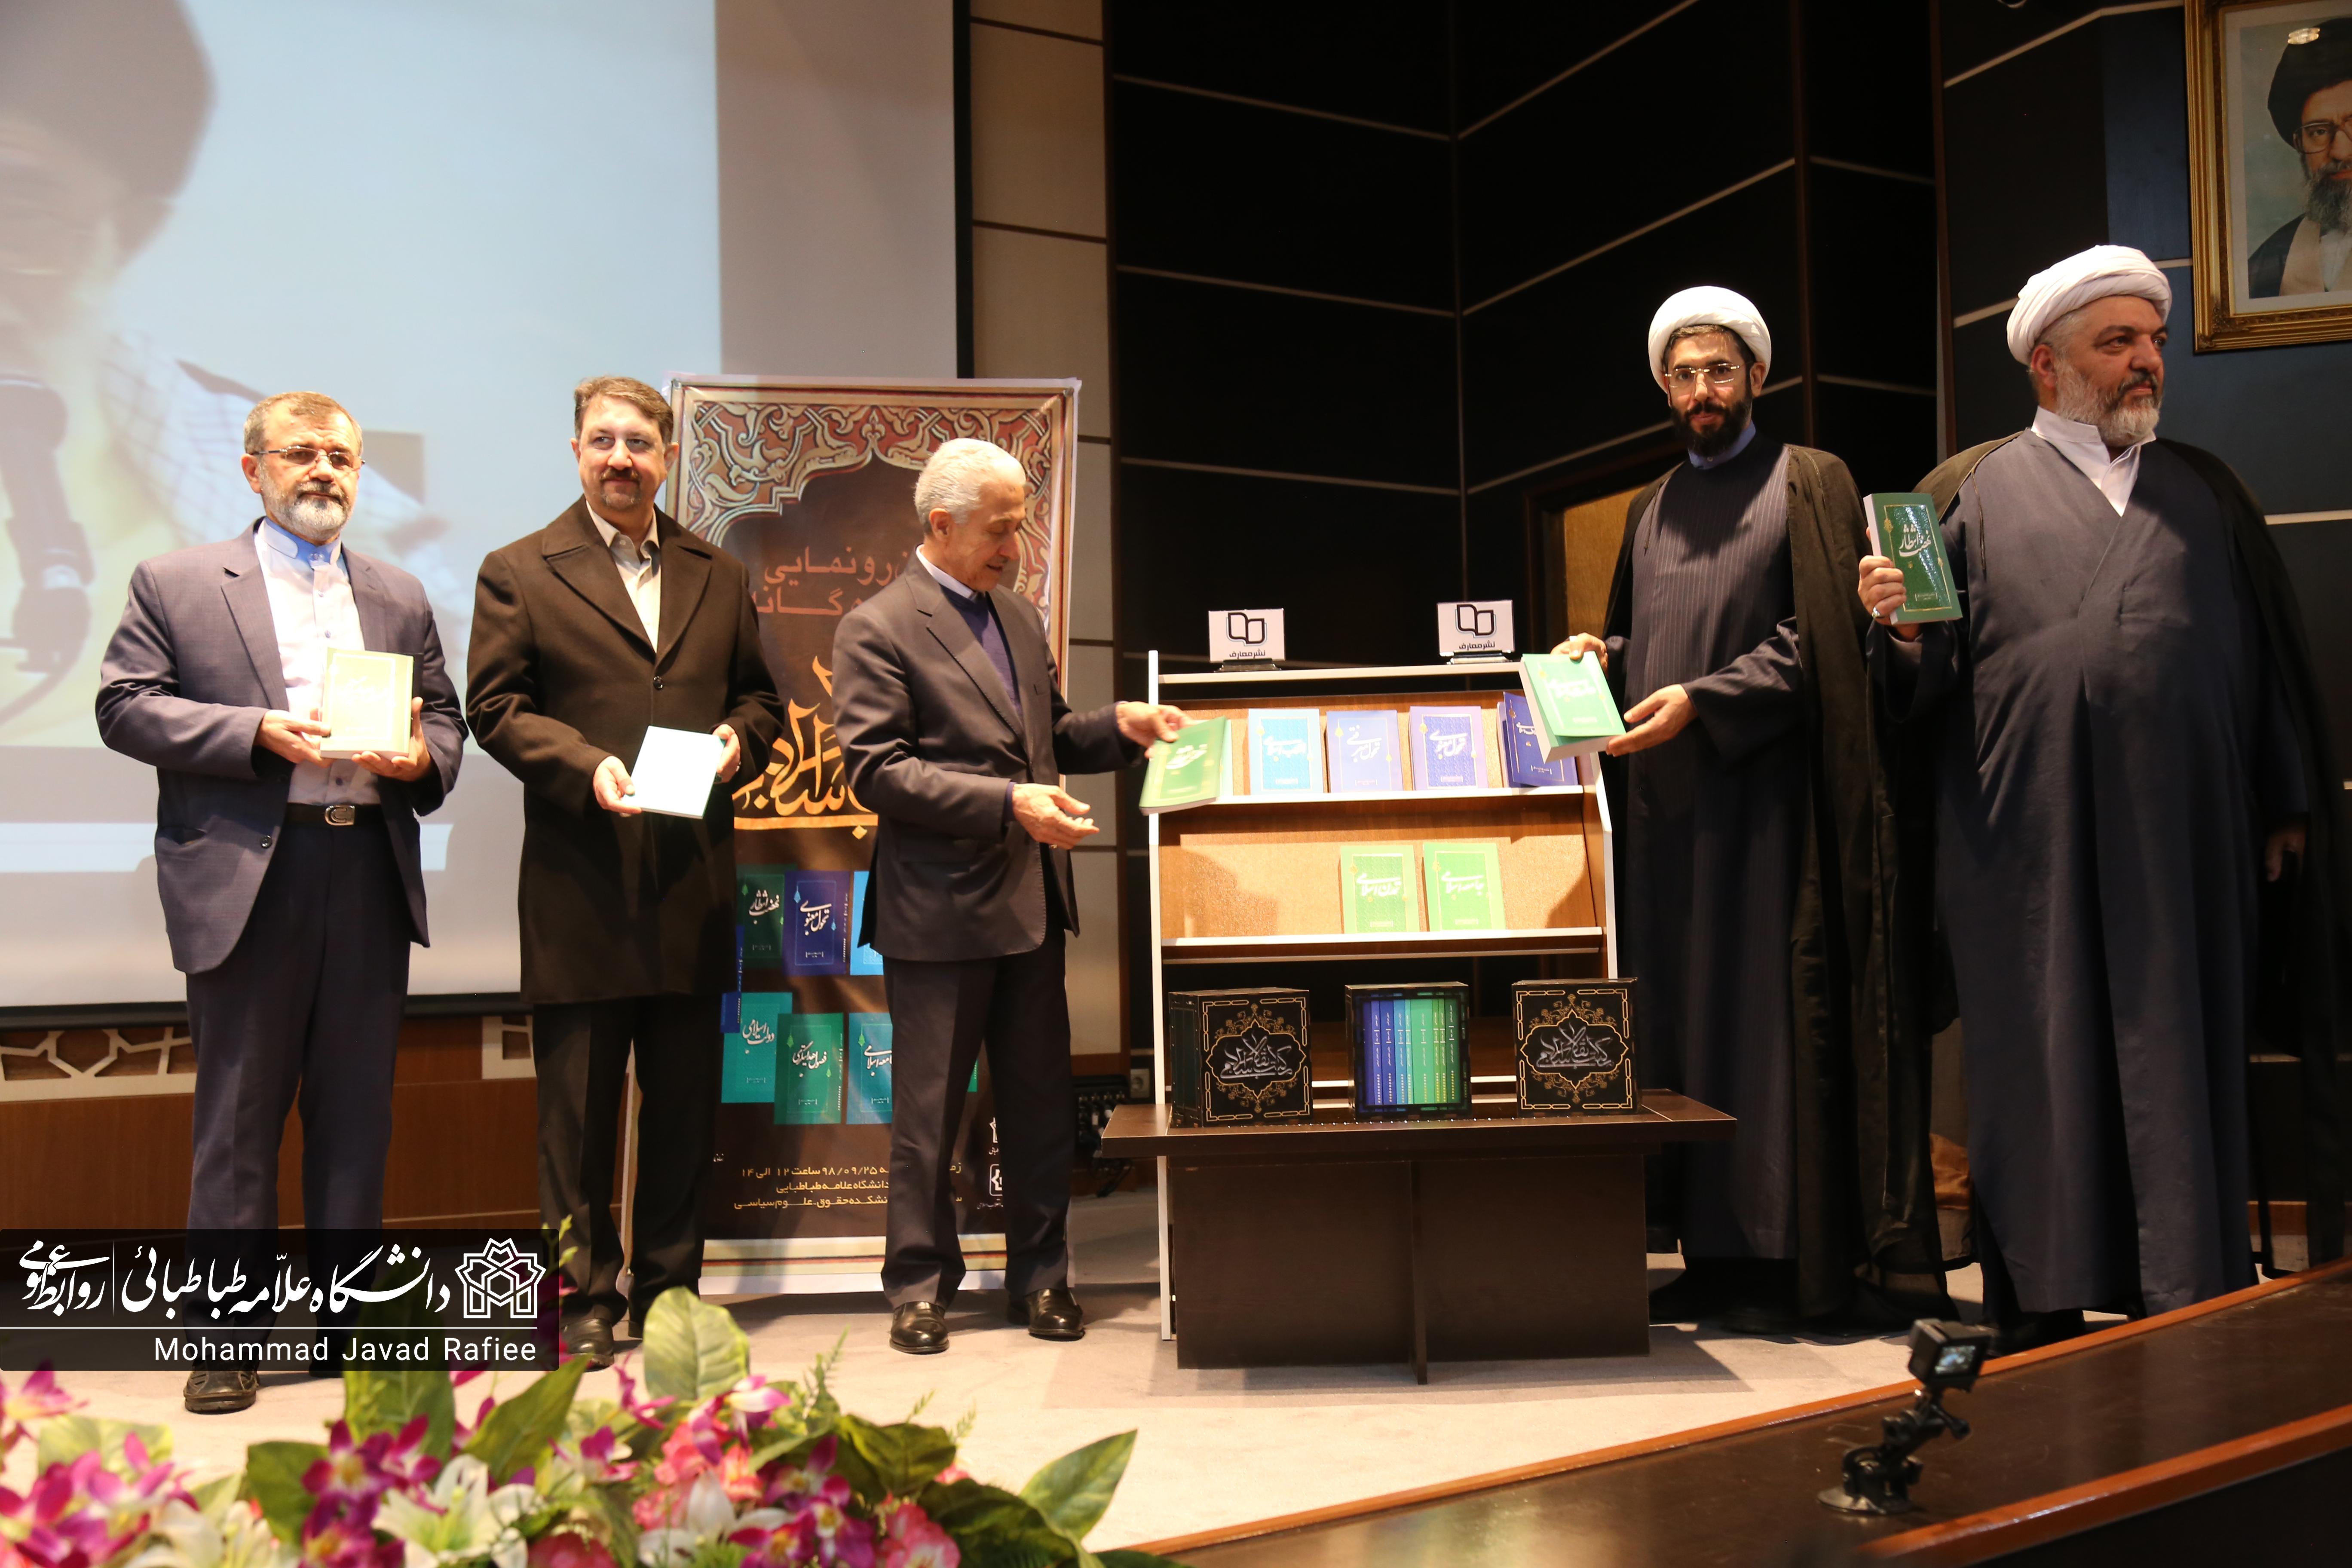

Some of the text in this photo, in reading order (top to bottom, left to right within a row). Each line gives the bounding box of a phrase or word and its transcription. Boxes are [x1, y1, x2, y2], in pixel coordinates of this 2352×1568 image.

[1229, 648, 1266, 660] نشر معارف
[756, 1167, 771, 1179] الی
[791, 1166, 821, 1176] ساعت
[776, 1181, 821, 1194] طباطبایی
[822, 1182, 853, 1190] علامه
[734, 1197, 775, 1210] سیاسی
[849, 1195, 888, 1205] نشکده
